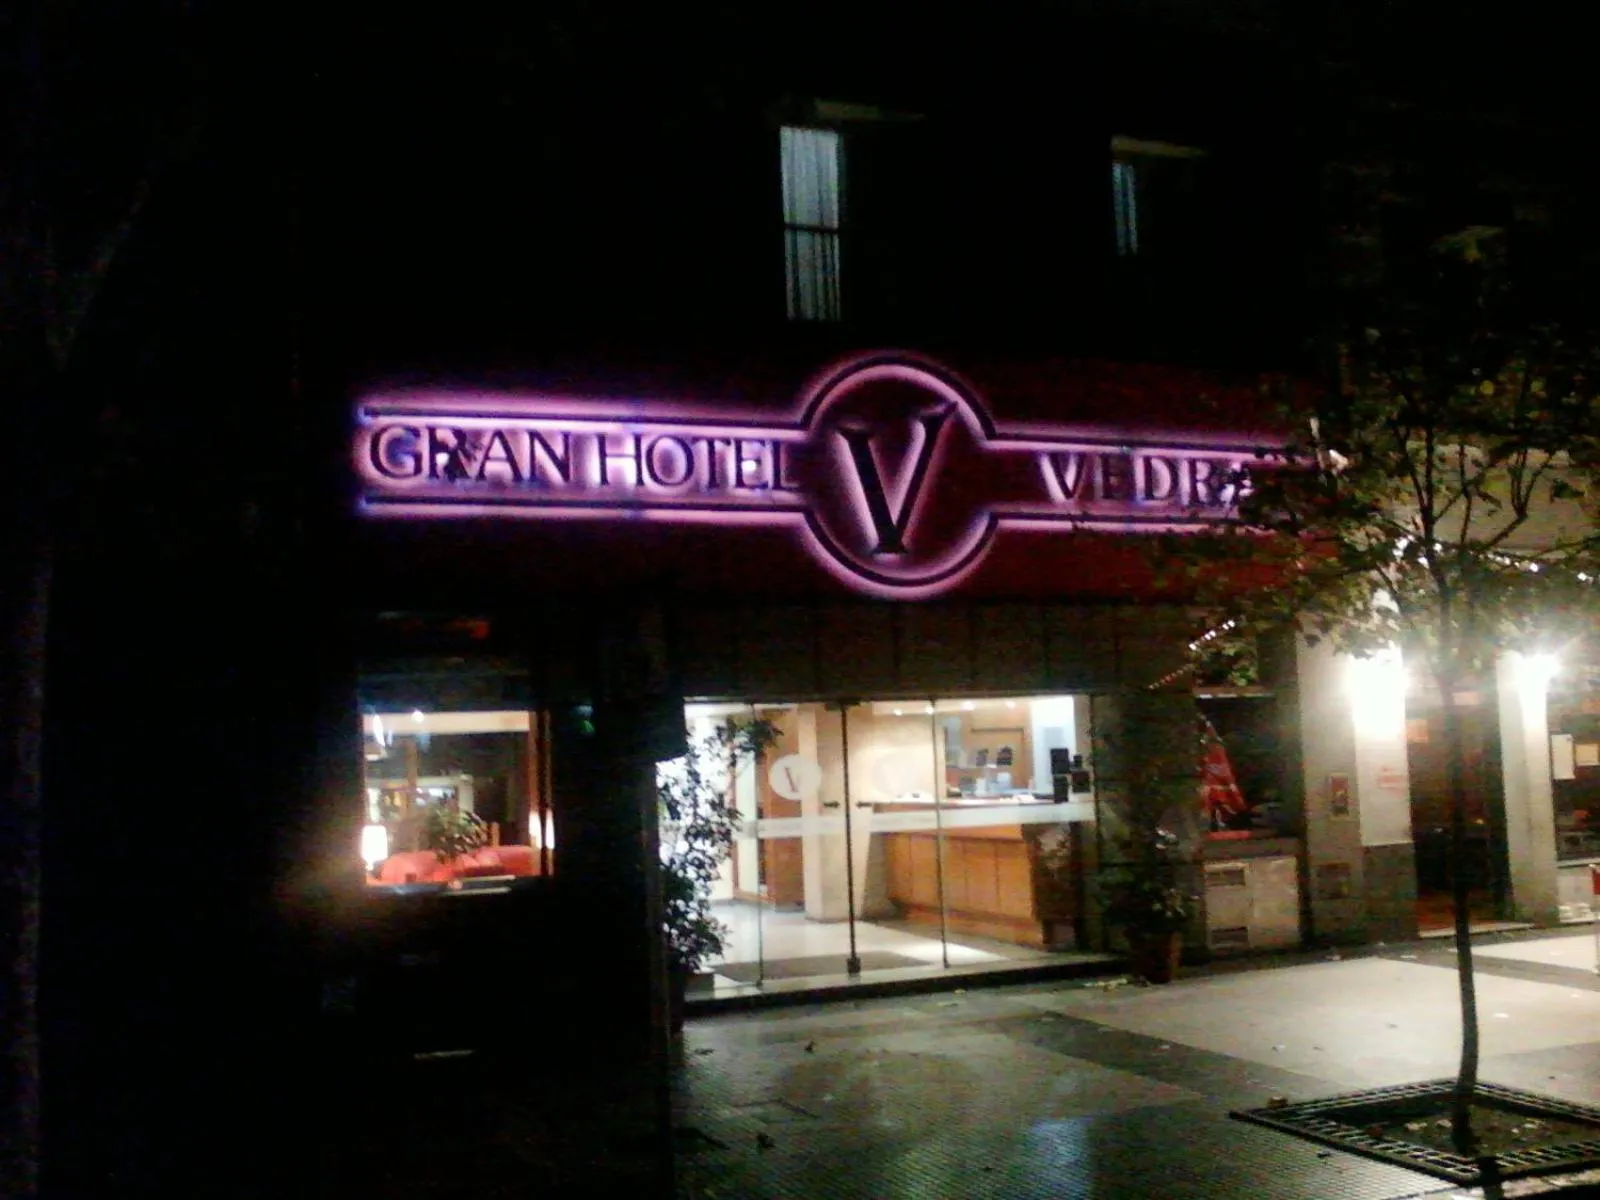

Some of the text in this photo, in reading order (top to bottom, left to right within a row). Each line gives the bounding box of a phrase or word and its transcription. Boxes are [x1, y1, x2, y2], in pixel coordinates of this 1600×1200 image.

[369, 426, 801, 491] GRAN HOTEL
[837, 403, 957, 555] V
